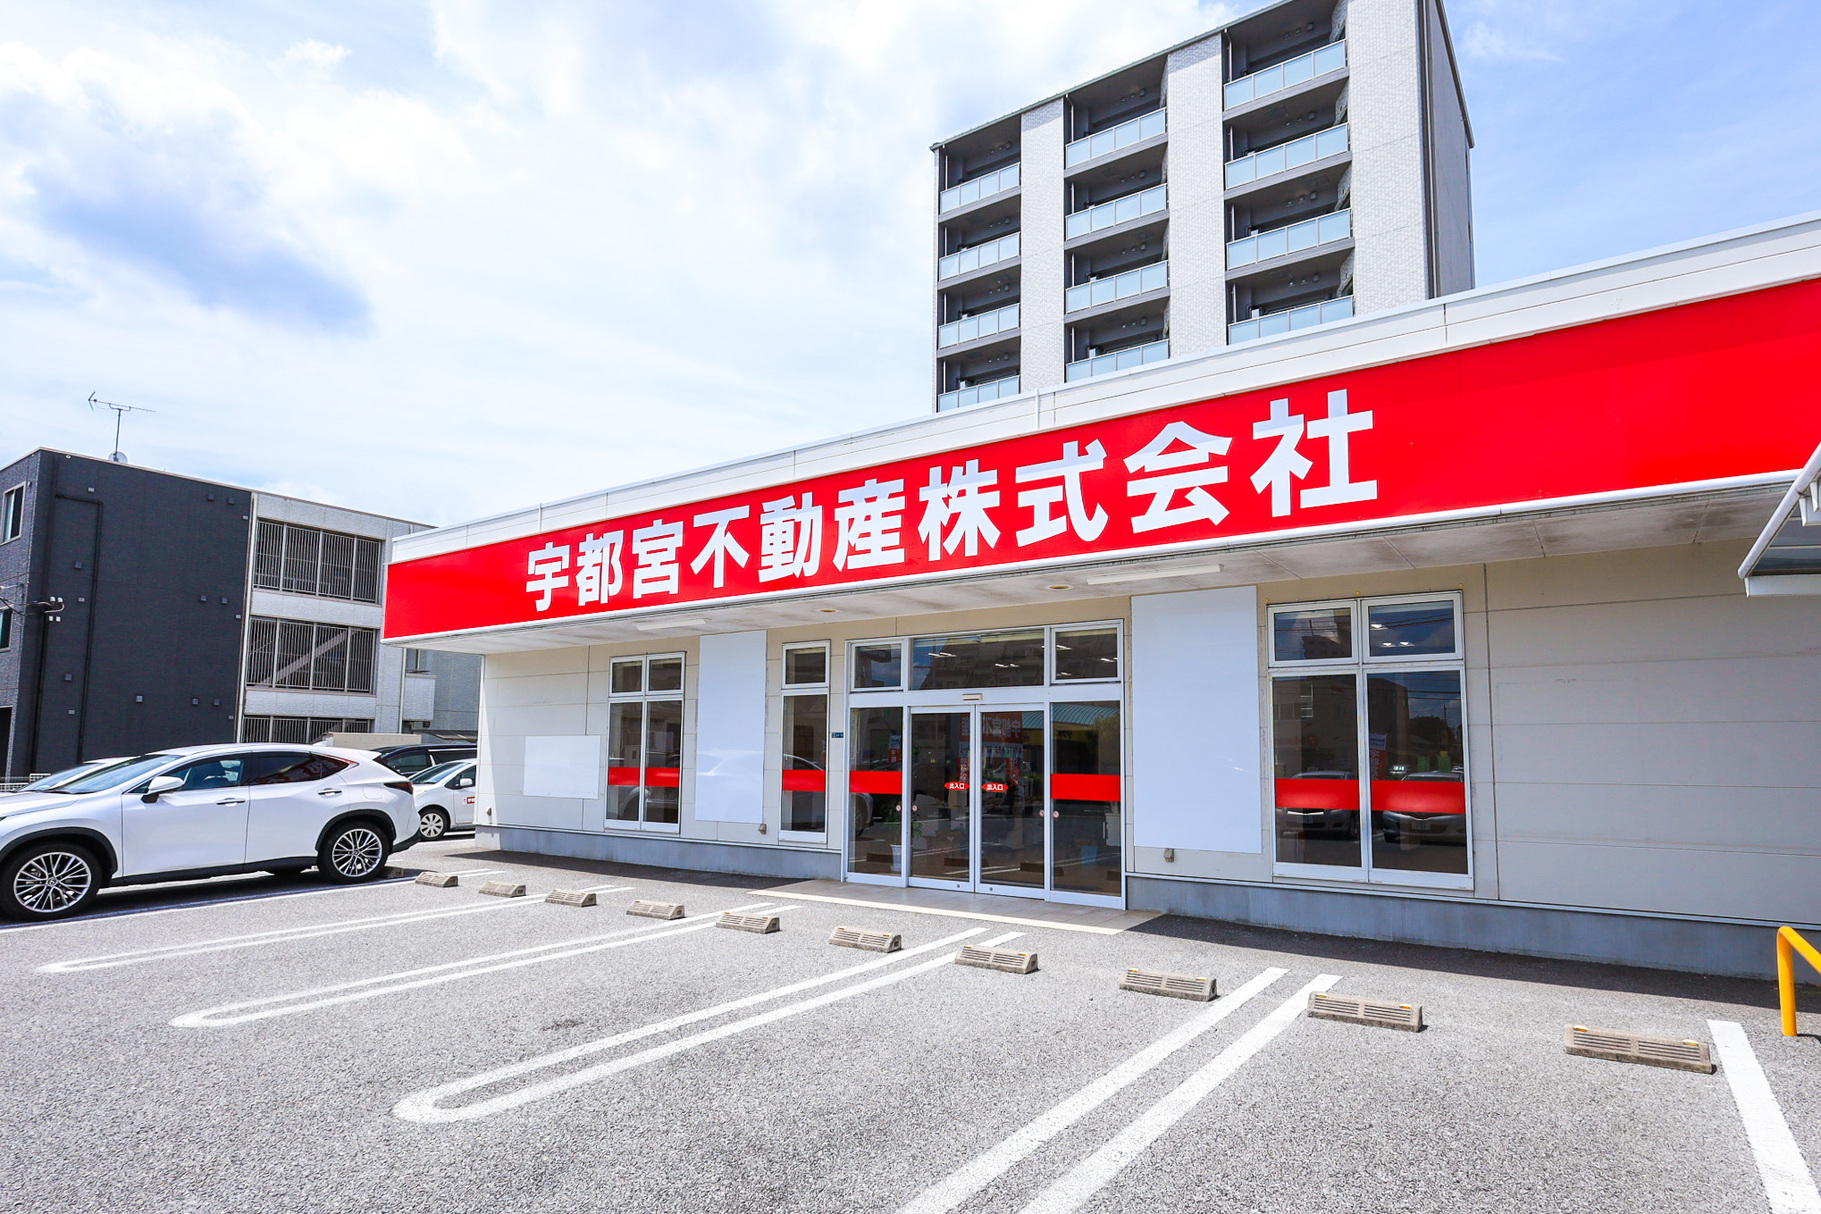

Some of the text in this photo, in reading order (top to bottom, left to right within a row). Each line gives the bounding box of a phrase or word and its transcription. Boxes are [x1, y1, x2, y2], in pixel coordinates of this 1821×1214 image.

[525, 388, 1379, 612] 宇都宮不動産株式会社
[949, 782, 965, 790] 出入口
[986, 783, 1004, 791] 出入口
